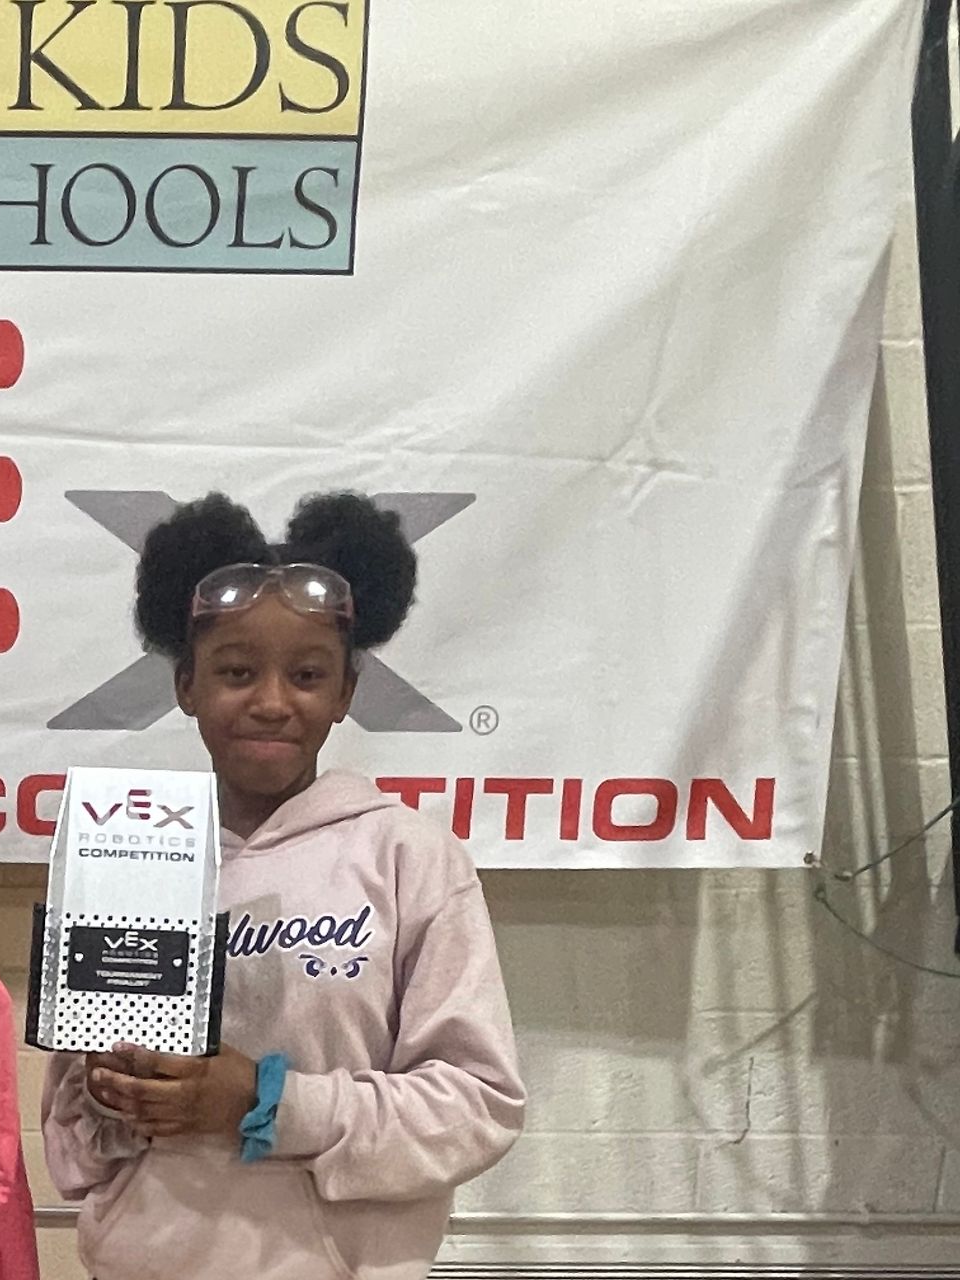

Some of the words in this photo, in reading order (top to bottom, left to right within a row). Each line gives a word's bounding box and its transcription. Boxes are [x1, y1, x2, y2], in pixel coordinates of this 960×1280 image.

[7, 0, 350, 114] KIDS
[82, 789, 195, 829] VEX
[78, 833, 196, 848] ROBOTICS
[78, 848, 195, 863] COMPETITION
[104, 931, 158, 951] VEX
